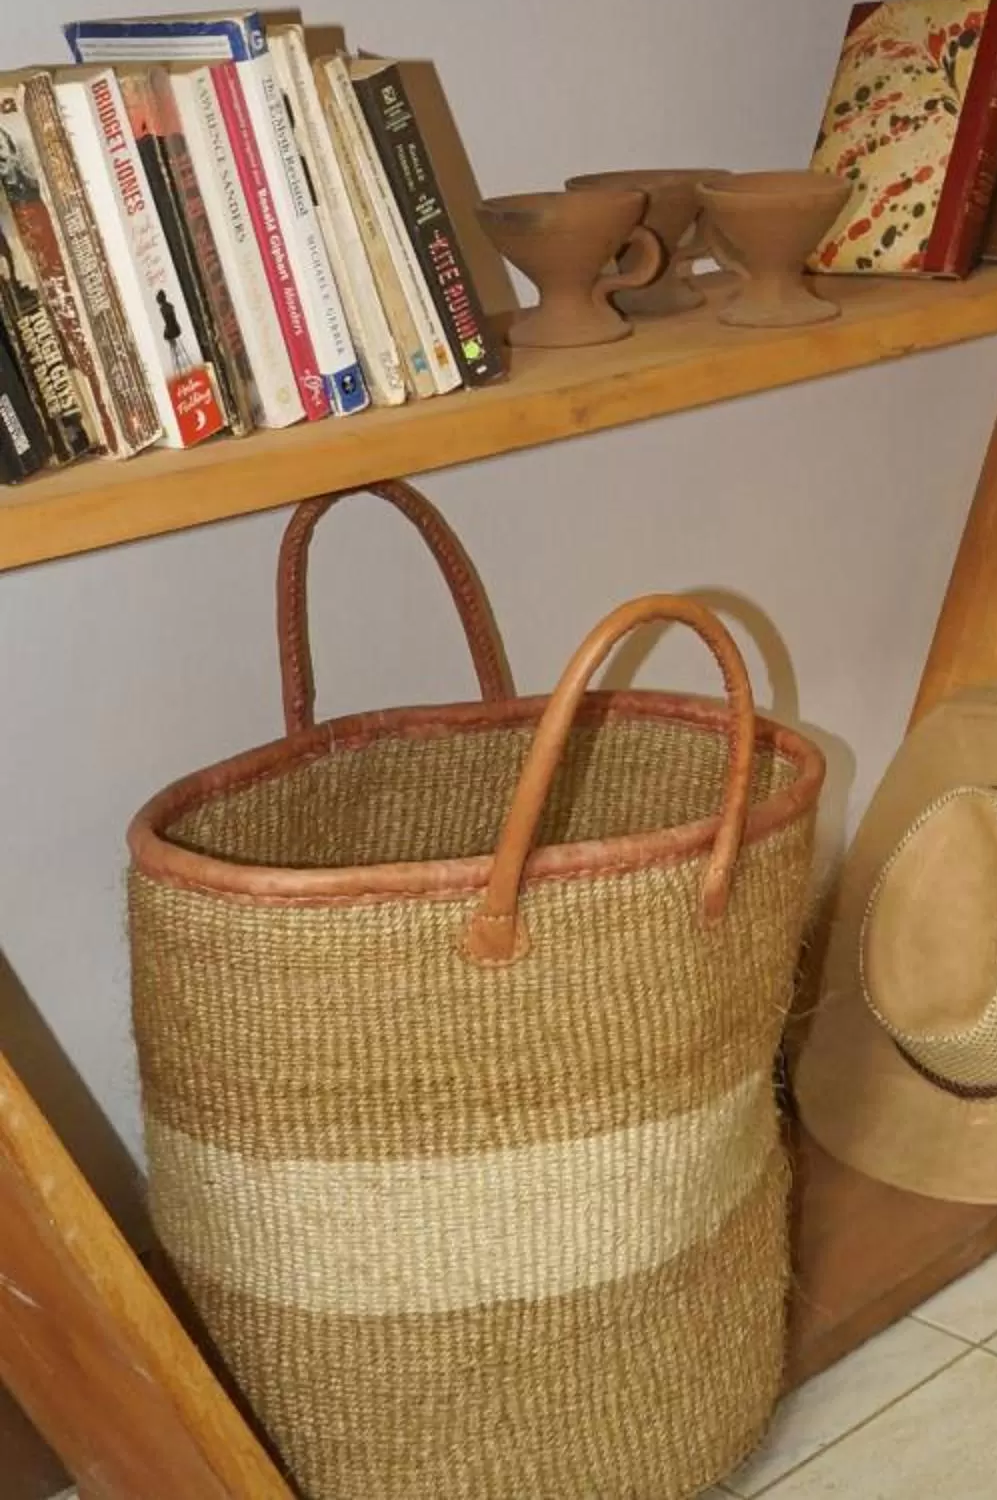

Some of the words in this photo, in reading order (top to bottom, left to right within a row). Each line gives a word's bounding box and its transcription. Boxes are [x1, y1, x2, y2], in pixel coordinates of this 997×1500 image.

[250, 30, 264, 50] G
[92, 78, 123, 153] BRIDGET
[114, 155, 145, 215] JONES
[196, 77, 228, 176] LAWRENCE
[219, 168, 247, 245] SANDERS
[255, 187, 276, 232] Ronald
[266, 233, 290, 282] Giphart
[282, 285, 304, 336] Moeders
[426, 235, 461, 286] KITE
[29, 307, 58, 359] TOUGH
